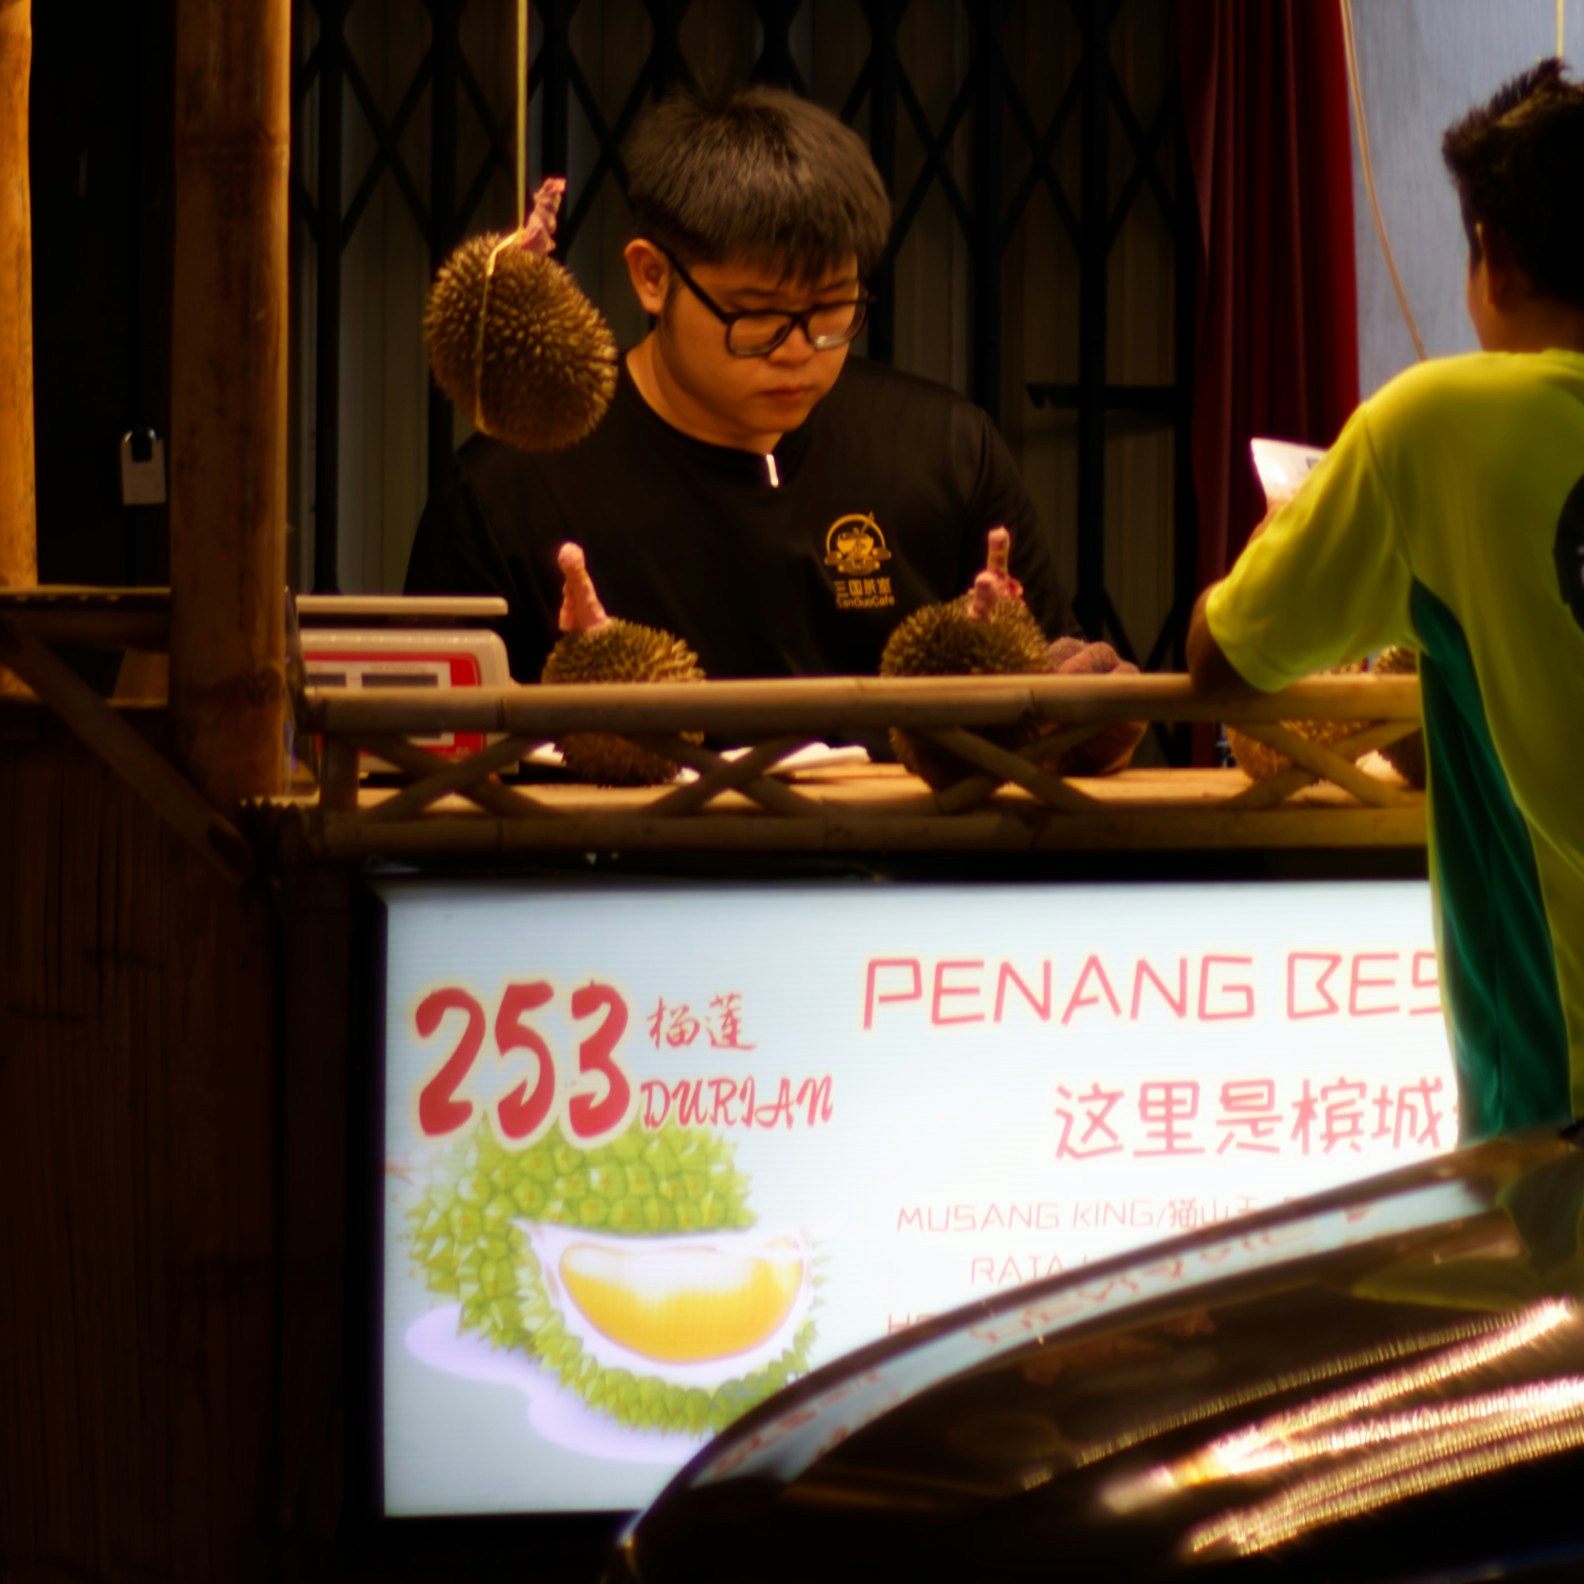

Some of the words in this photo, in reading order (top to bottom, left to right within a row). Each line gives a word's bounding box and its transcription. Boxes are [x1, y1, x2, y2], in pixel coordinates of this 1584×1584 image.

[862, 953, 1256, 1031] PENANG
[415, 979, 631, 1139] 253
[640, 1075, 834, 1131] DURIAN
[1053, 1076, 1446, 1162] 这里是槟城
[896, 1200, 1061, 1232] MUSANG
